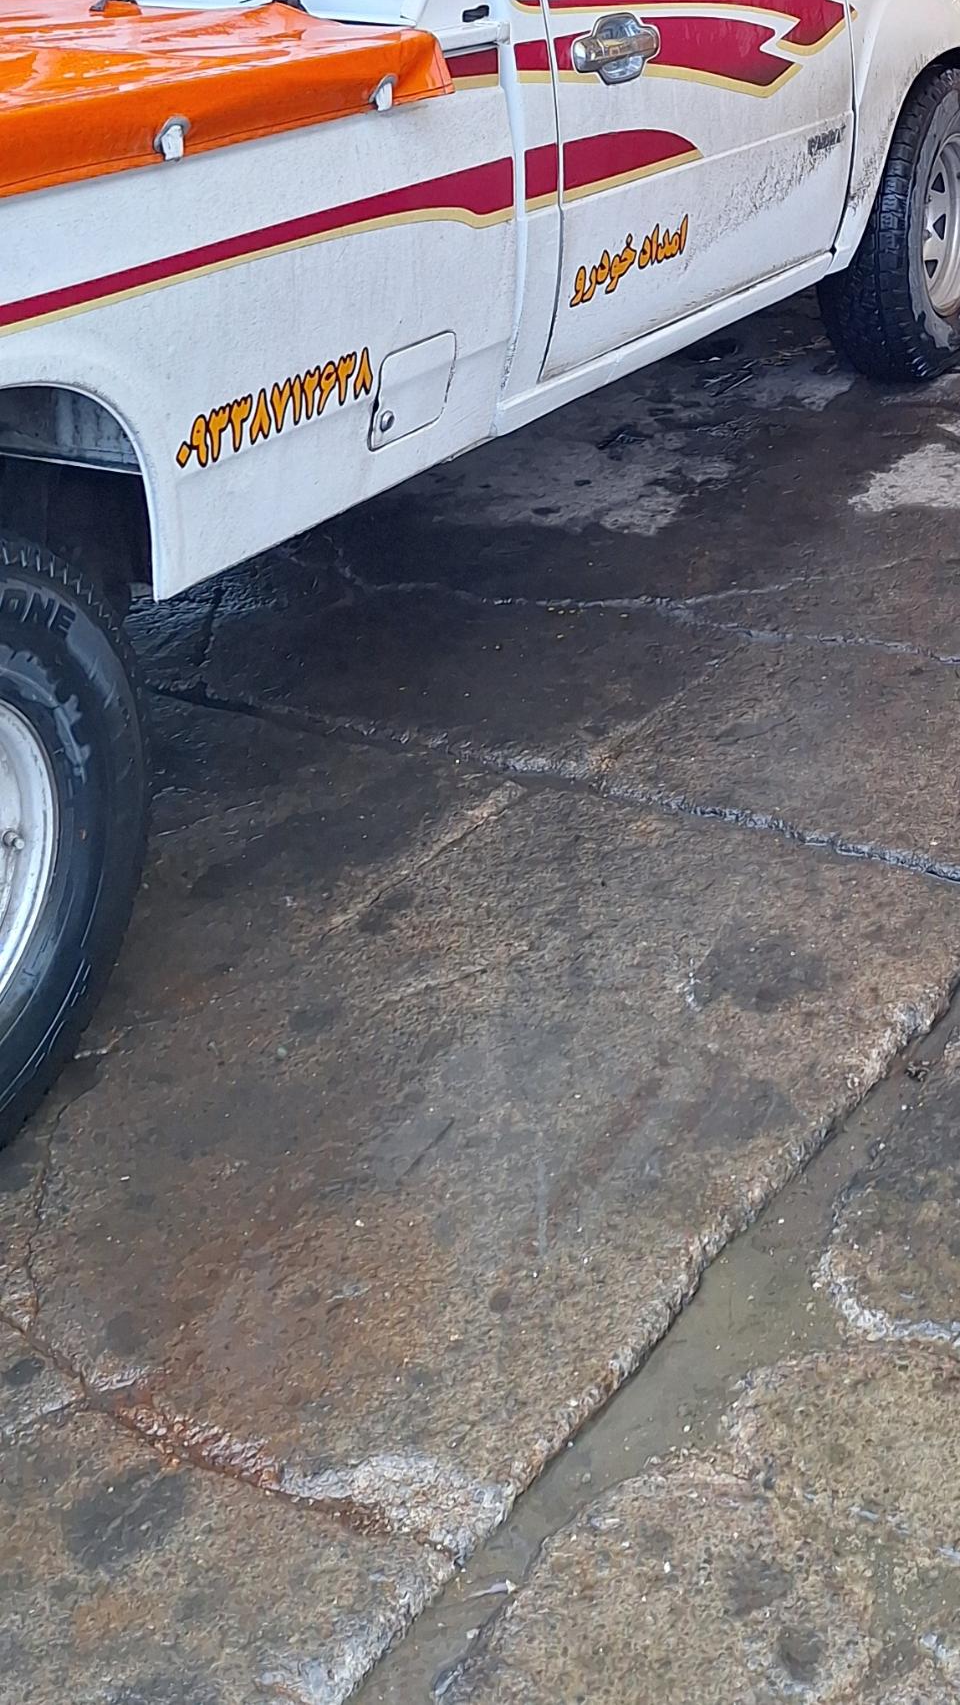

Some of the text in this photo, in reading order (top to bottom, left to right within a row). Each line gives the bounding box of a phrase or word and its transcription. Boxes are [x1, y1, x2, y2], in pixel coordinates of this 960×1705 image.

[569, 213, 689, 308] امداد خودرو
[175, 346, 374, 469] ۰۹۳۳۸۷۱۲۶۳۸
